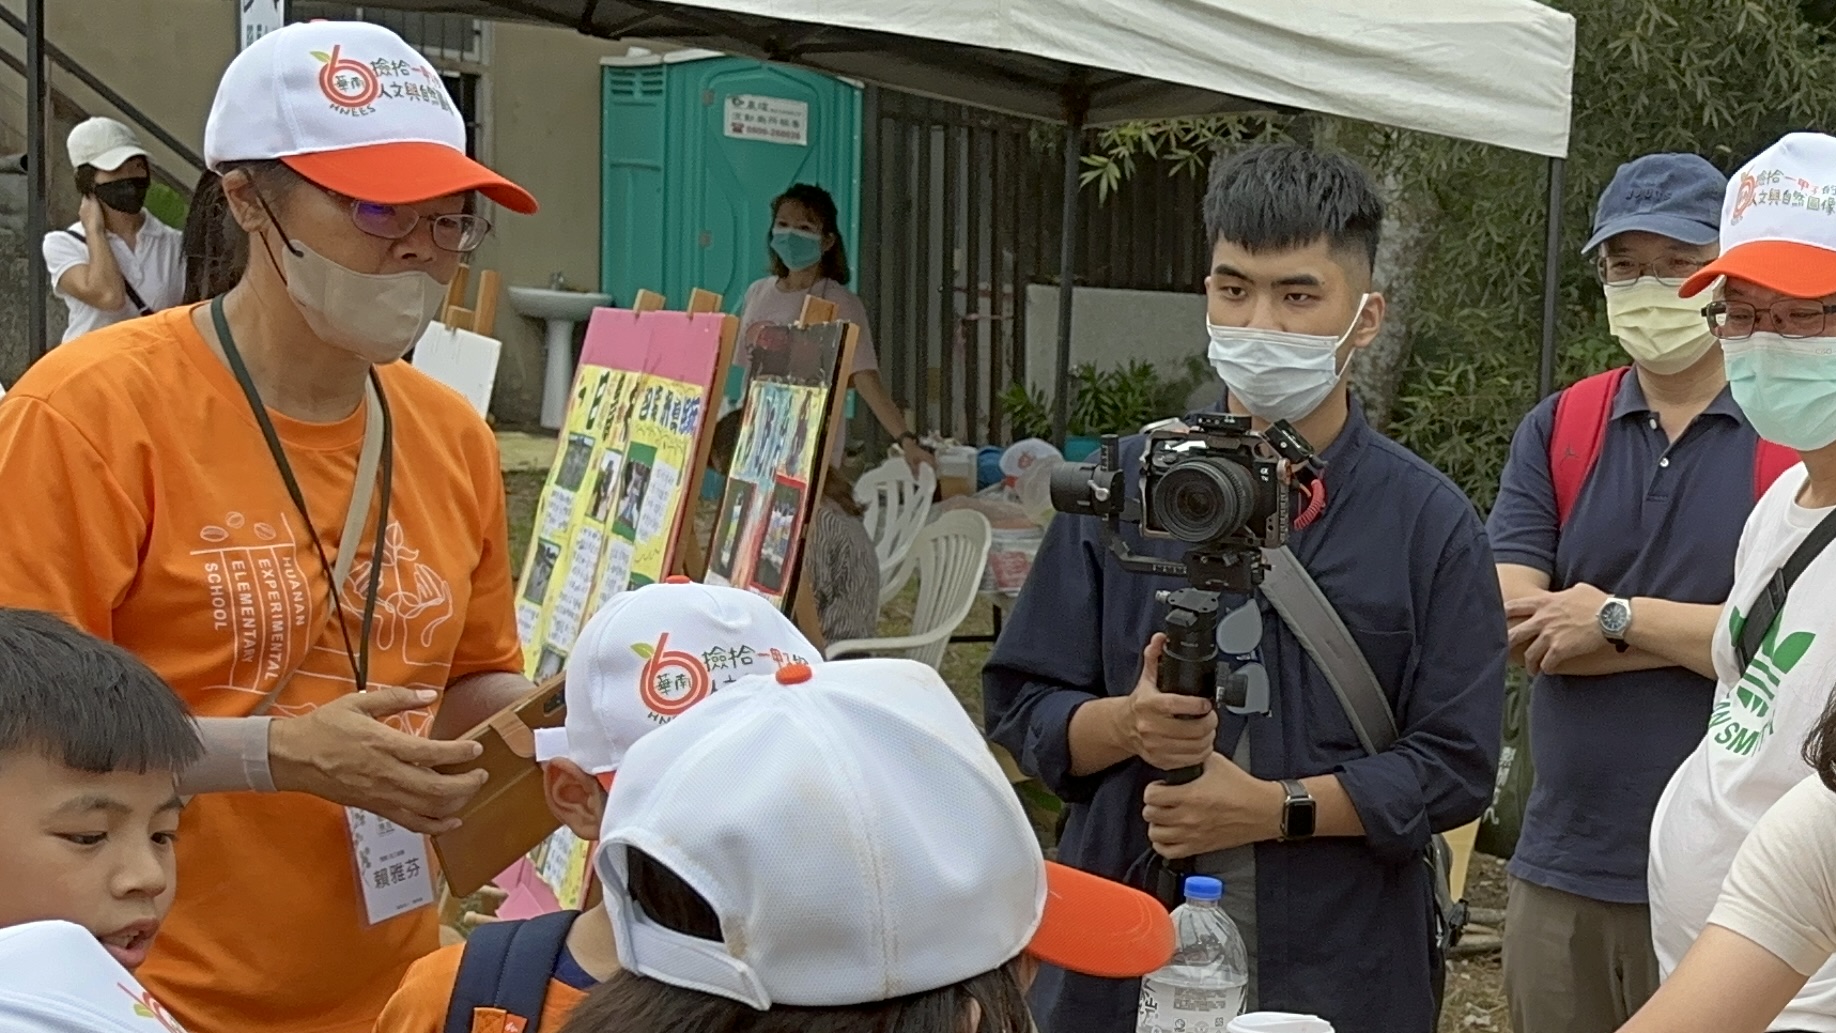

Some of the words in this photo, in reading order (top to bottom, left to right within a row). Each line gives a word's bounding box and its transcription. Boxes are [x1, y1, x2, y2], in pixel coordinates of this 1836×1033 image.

[204, 562, 228, 632] SCHOOL
[231, 560, 258, 664] ELEMENTARY
[257, 558, 284, 682] EXPERIMENTAL
[281, 556, 306, 627] HUANAN
